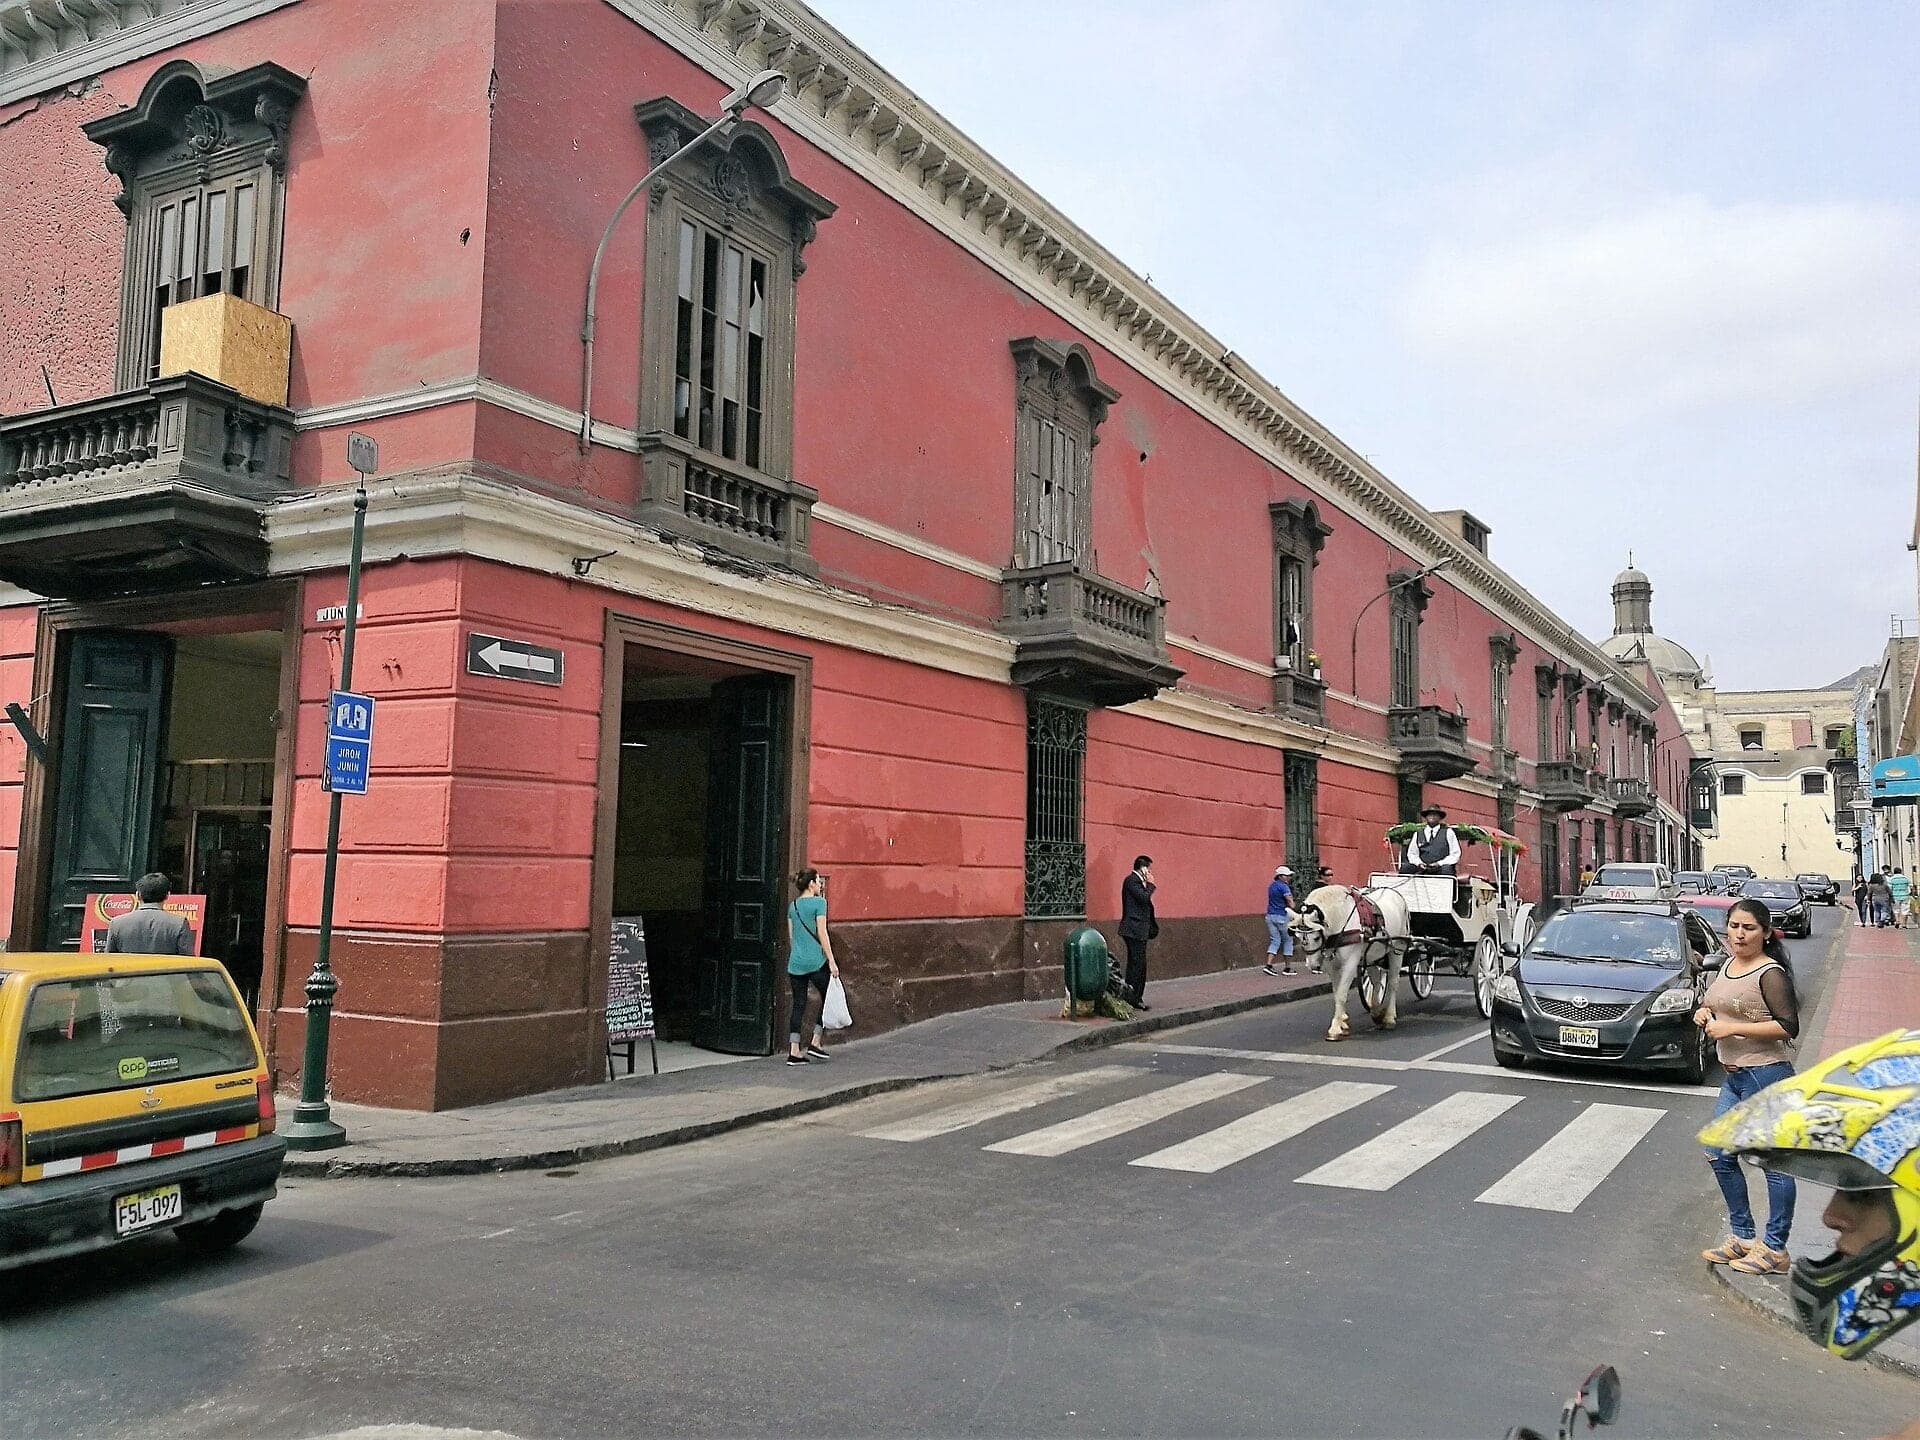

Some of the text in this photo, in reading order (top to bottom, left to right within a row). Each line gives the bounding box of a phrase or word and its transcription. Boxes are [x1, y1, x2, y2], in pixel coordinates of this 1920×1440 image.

[338, 748, 361, 759] JIRON
[337, 761, 359, 773] JUNIN
[1610, 890, 1631, 898] TAXI
[121, 1062, 145, 1074] RPP
[119, 1193, 178, 1228] F5L-097
